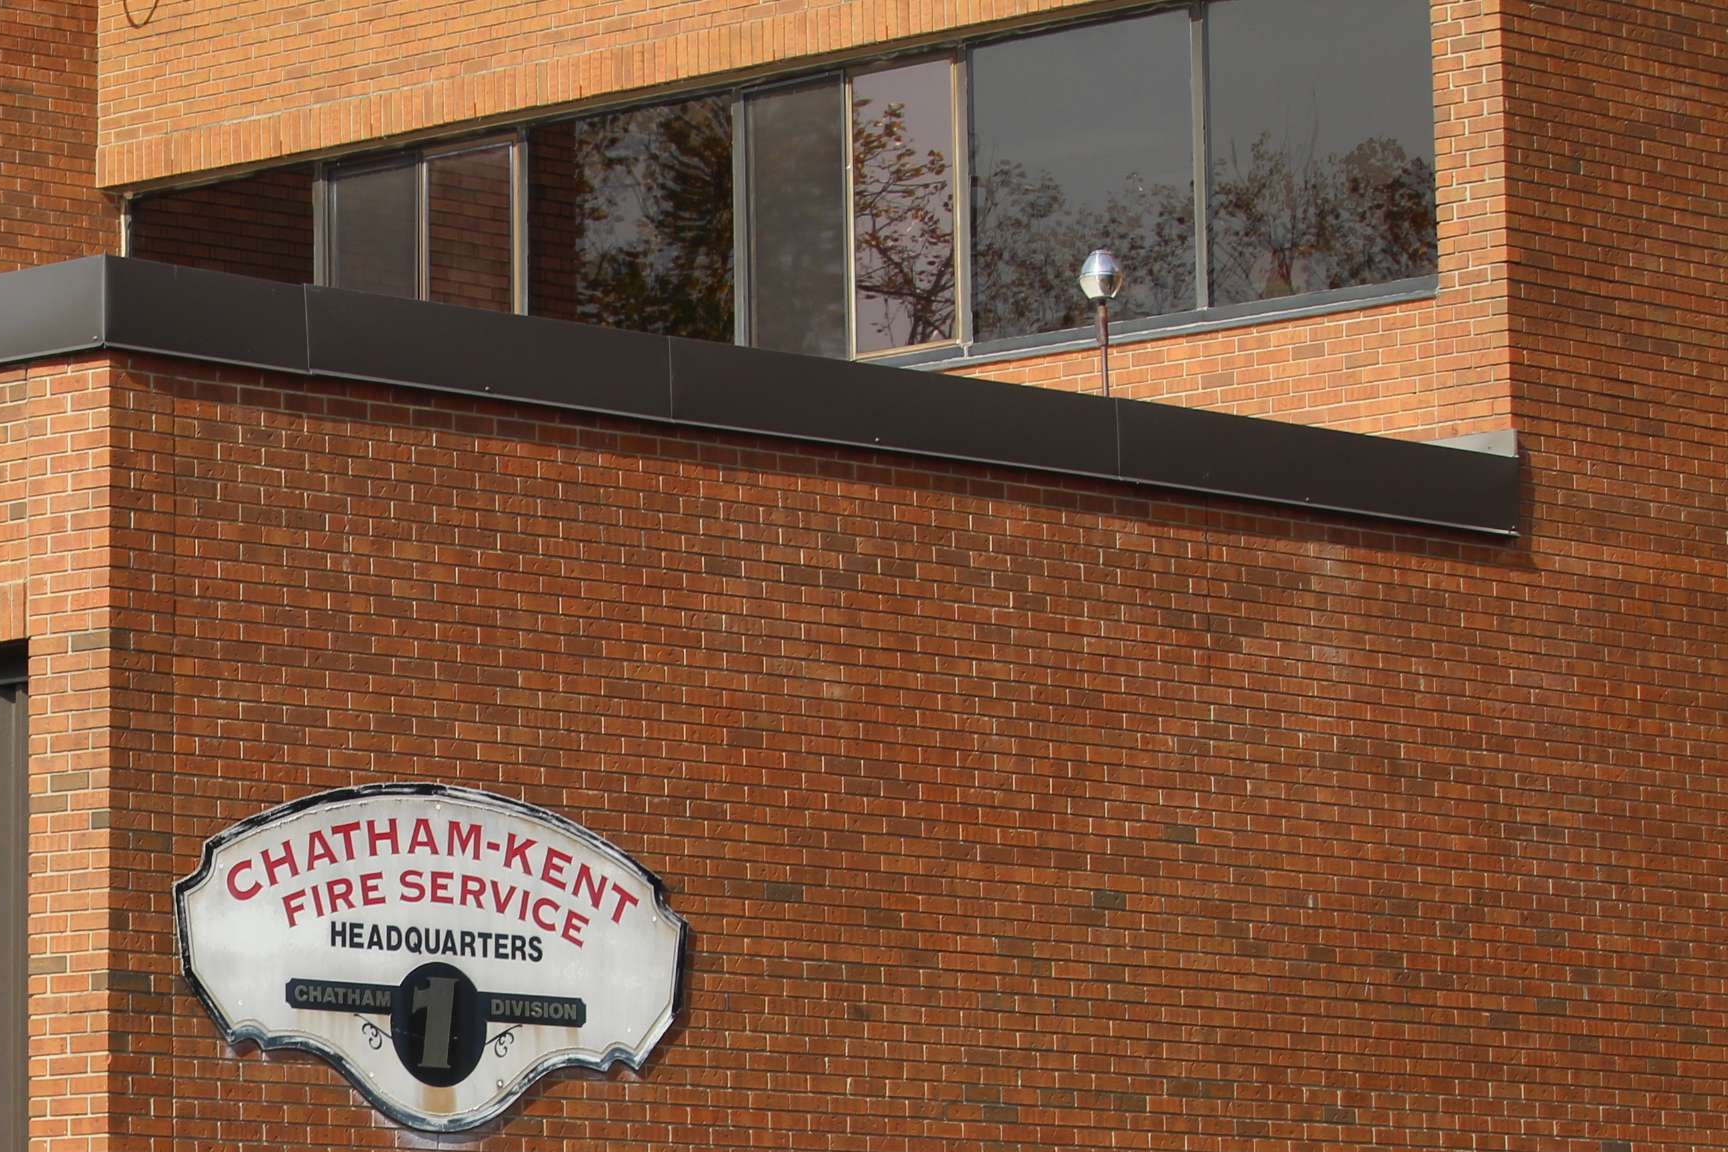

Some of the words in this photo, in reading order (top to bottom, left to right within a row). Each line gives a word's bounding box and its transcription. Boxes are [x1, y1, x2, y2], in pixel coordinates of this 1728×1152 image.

[226, 817, 639, 925] CHATHAM-KENT
[281, 871, 387, 929] FIRE
[399, 869, 591, 948] SERVICE
[330, 920, 543, 963] HEADQUARTERS
[293, 984, 392, 1008] CHATHAM
[411, 976, 460, 1069] 1
[490, 998, 578, 1021] DIVISION
